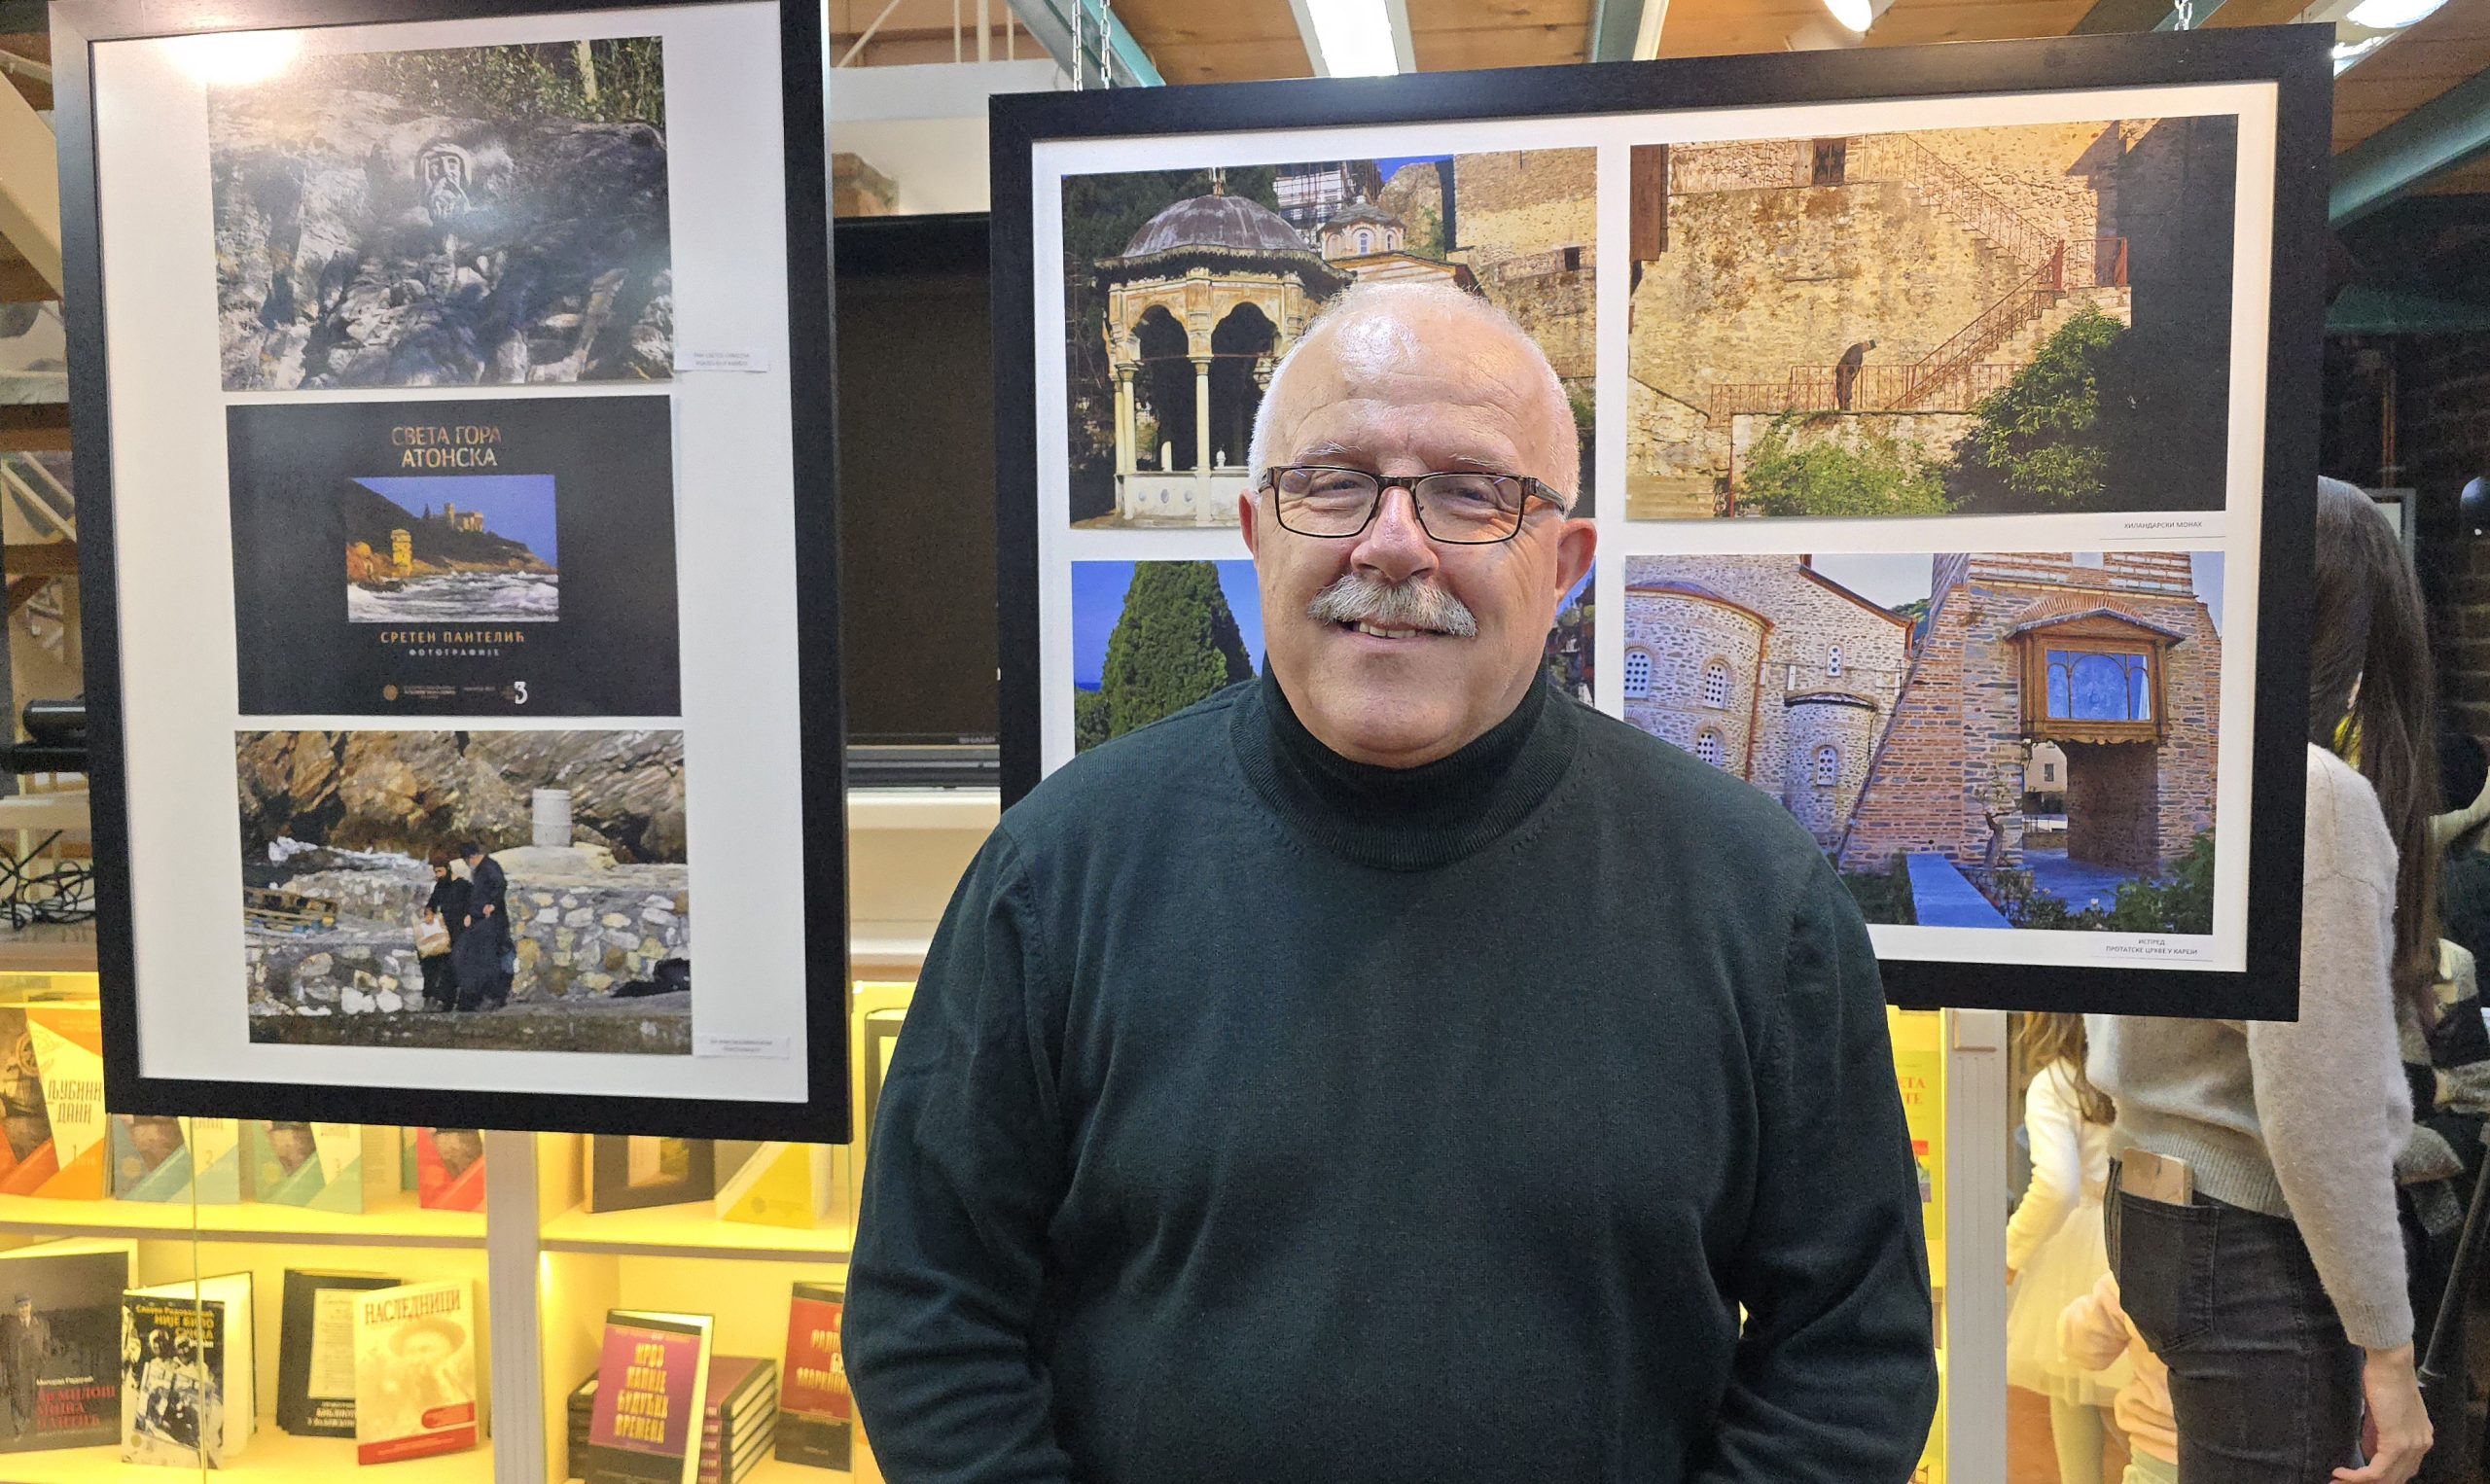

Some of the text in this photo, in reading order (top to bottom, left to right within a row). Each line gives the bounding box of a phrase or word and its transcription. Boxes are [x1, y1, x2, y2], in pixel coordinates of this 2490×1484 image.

[392, 425, 502, 445] СВЕТА ГОРА
[401, 447, 498, 468] АТОНСКА
[380, 631, 525, 644] СРЕТЕН ПАНТЕЛИЋ
[409, 648, 500, 656] ФОТОГРАФИЈЕ
[365, 1289, 461, 1325] НАСЛЕДНИЦИ
